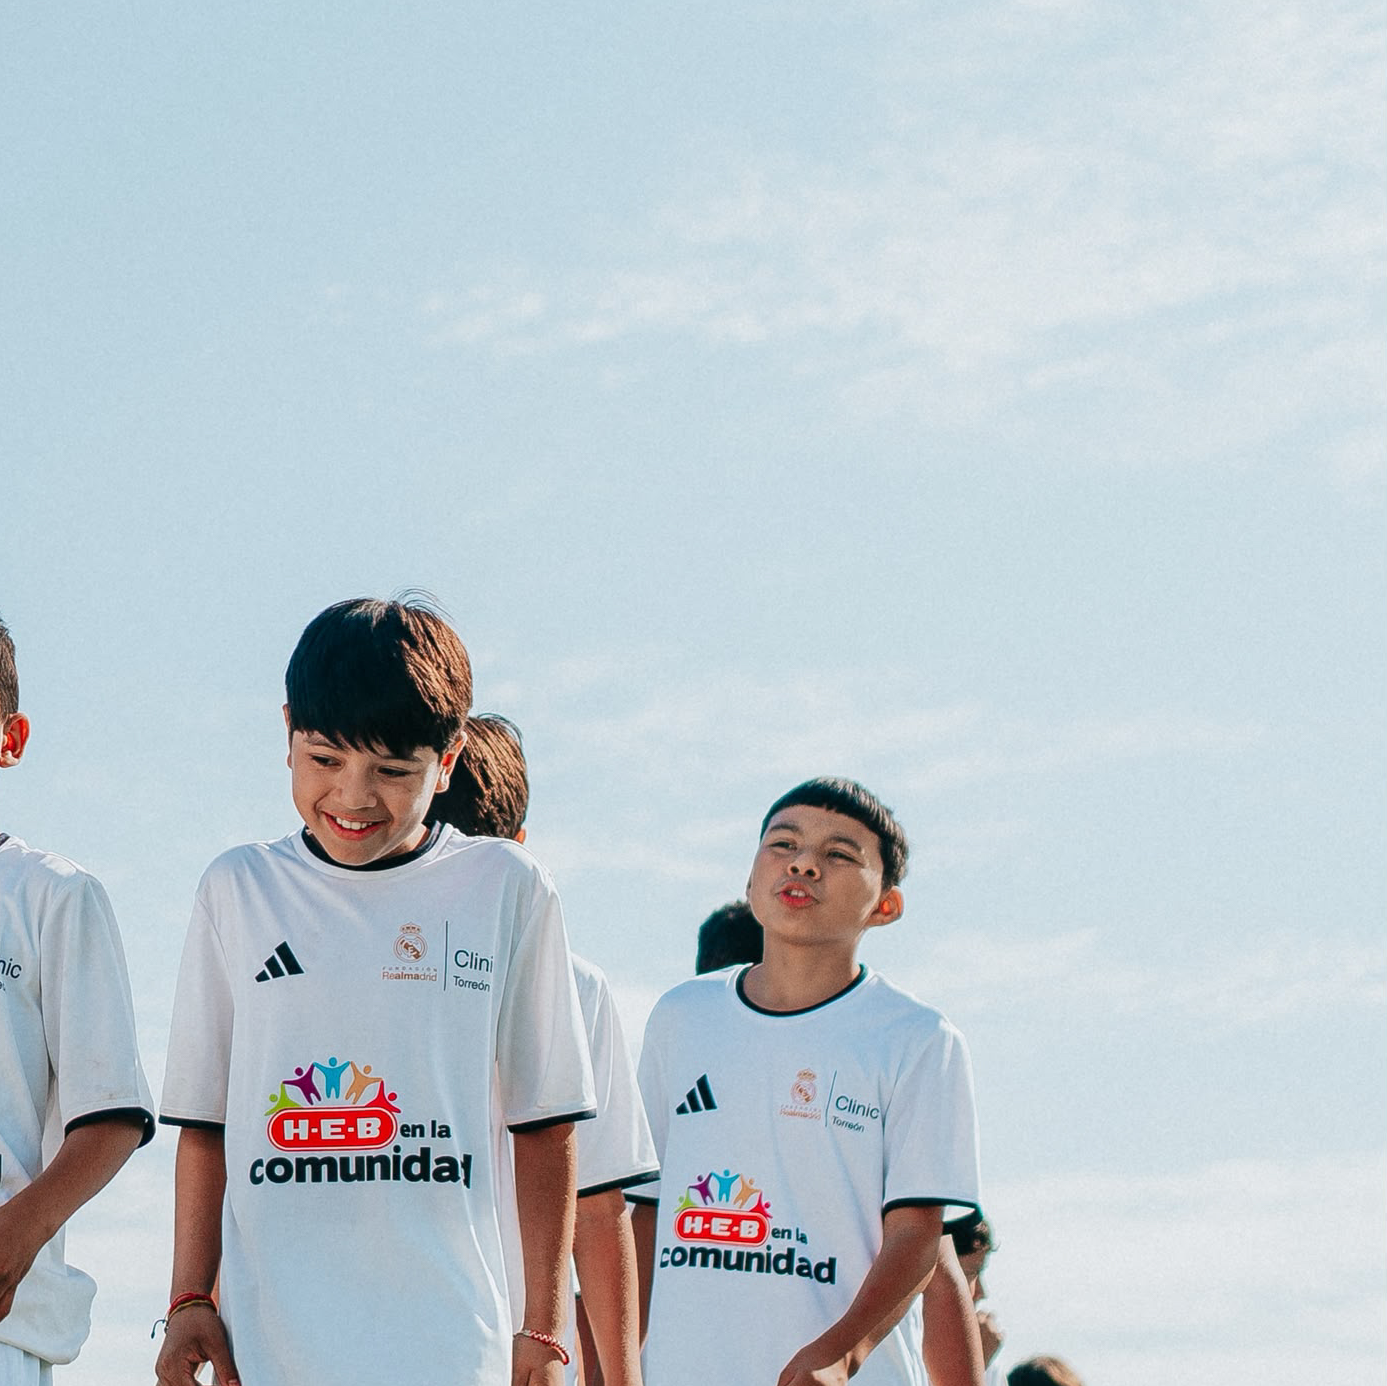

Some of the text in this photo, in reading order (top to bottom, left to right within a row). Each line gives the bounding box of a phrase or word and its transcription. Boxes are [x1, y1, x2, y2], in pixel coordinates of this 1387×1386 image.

[382, 971, 437, 981] Realmadrid
[452, 975, 491, 992] Torreón
[835, 1095, 880, 1119] Clinic
[399, 1123, 425, 1138] en
[430, 1119, 451, 1139] la
[832, 1115, 865, 1132] Torreón
[771, 1227, 791, 1240] en
[795, 1227, 808, 1244] la
[660, 1244, 837, 1285] comunidad
